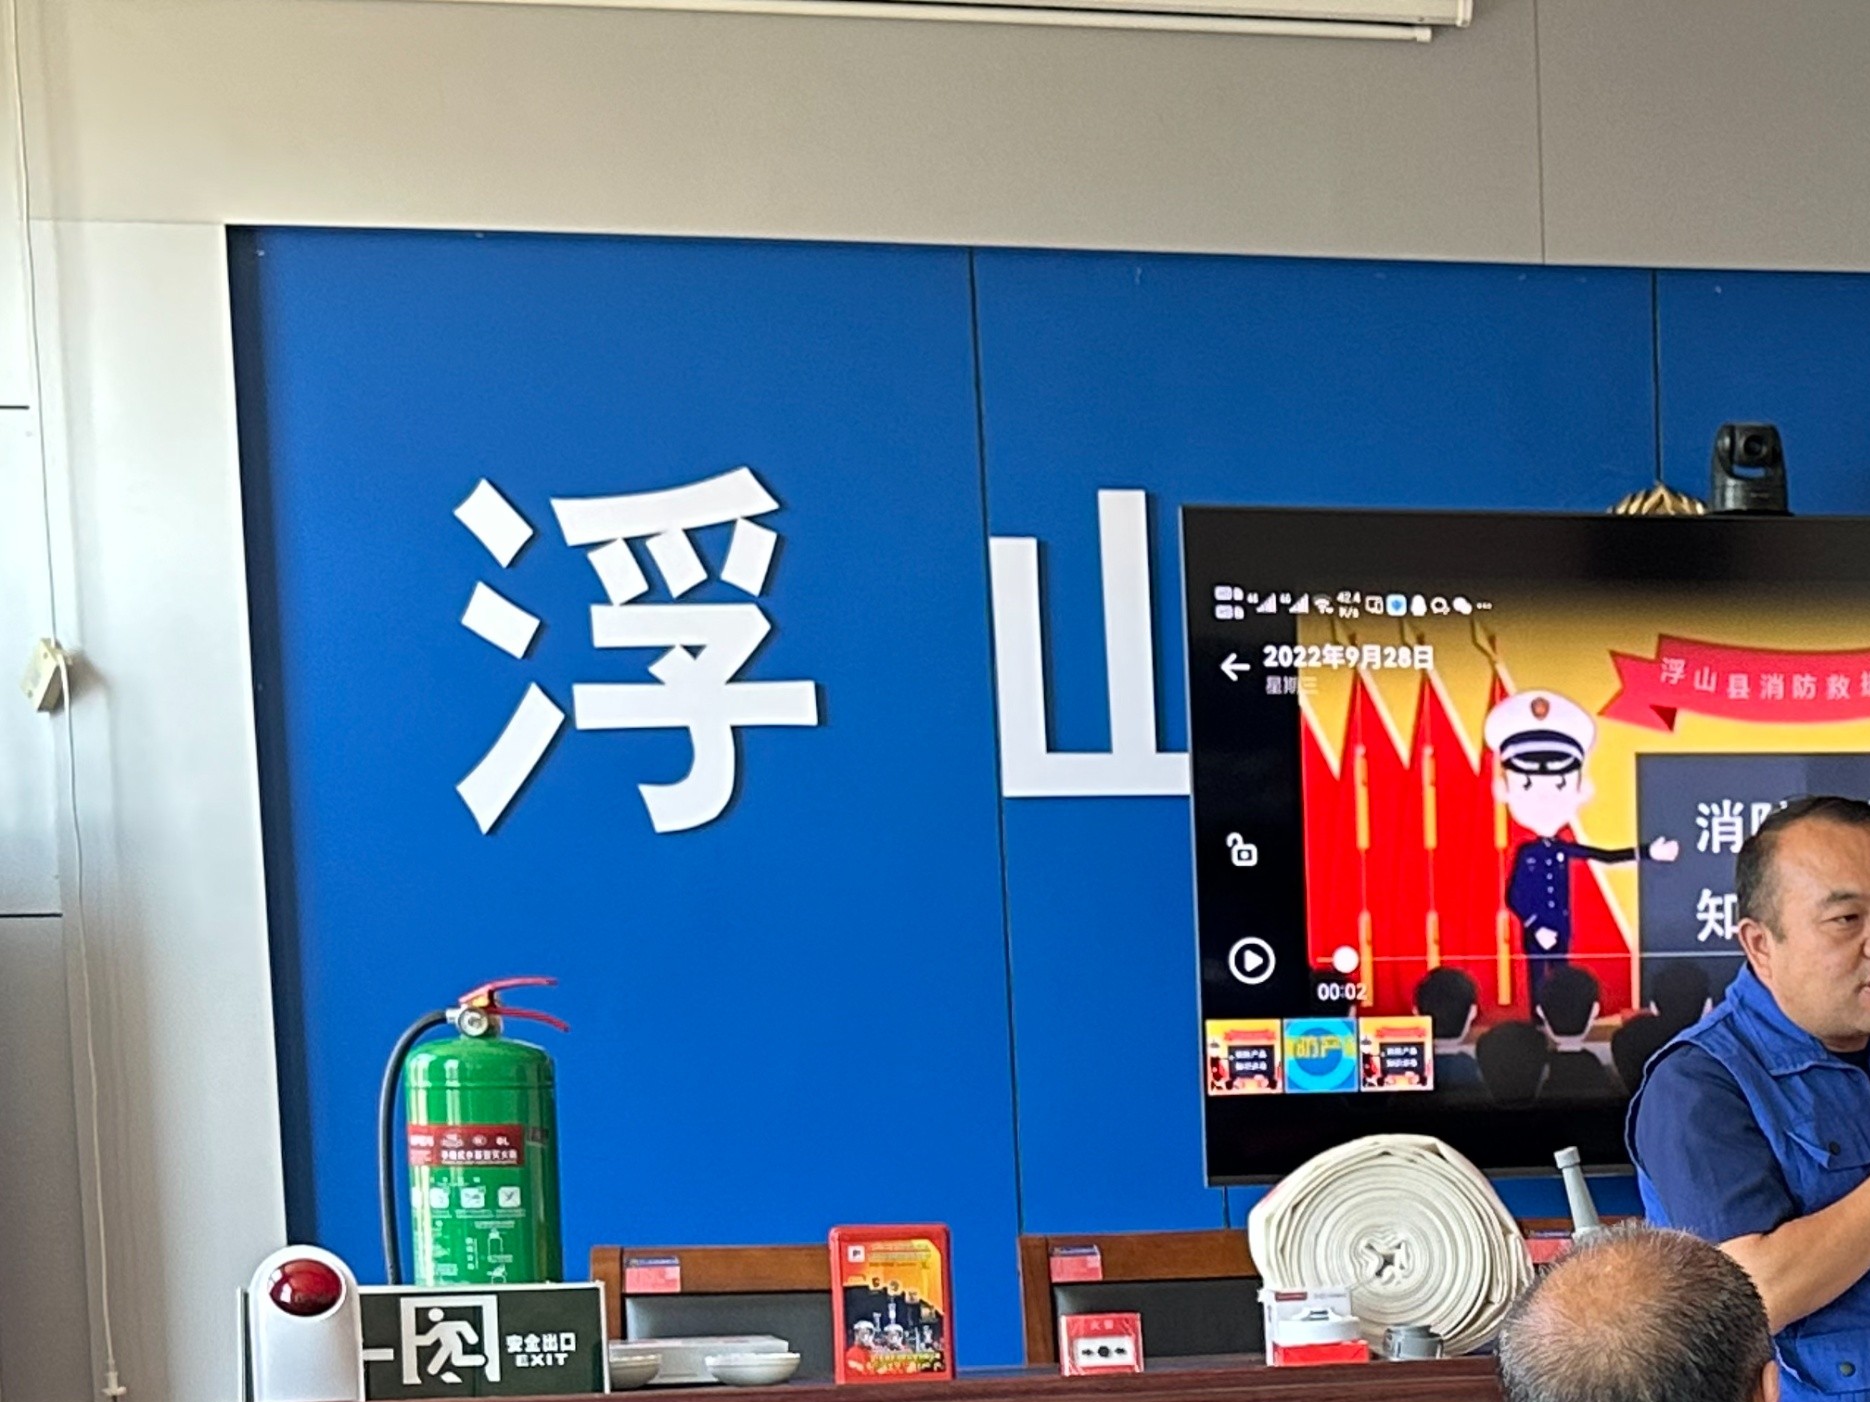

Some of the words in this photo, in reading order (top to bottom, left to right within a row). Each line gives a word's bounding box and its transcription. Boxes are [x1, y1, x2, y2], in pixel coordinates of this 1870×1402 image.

[1262, 643, 1435, 670] 2022年9月28日
[1317, 982, 1368, 1001] 00:02
[505, 1332, 577, 1354] 安全出口
[515, 1352, 569, 1368] EXIT
